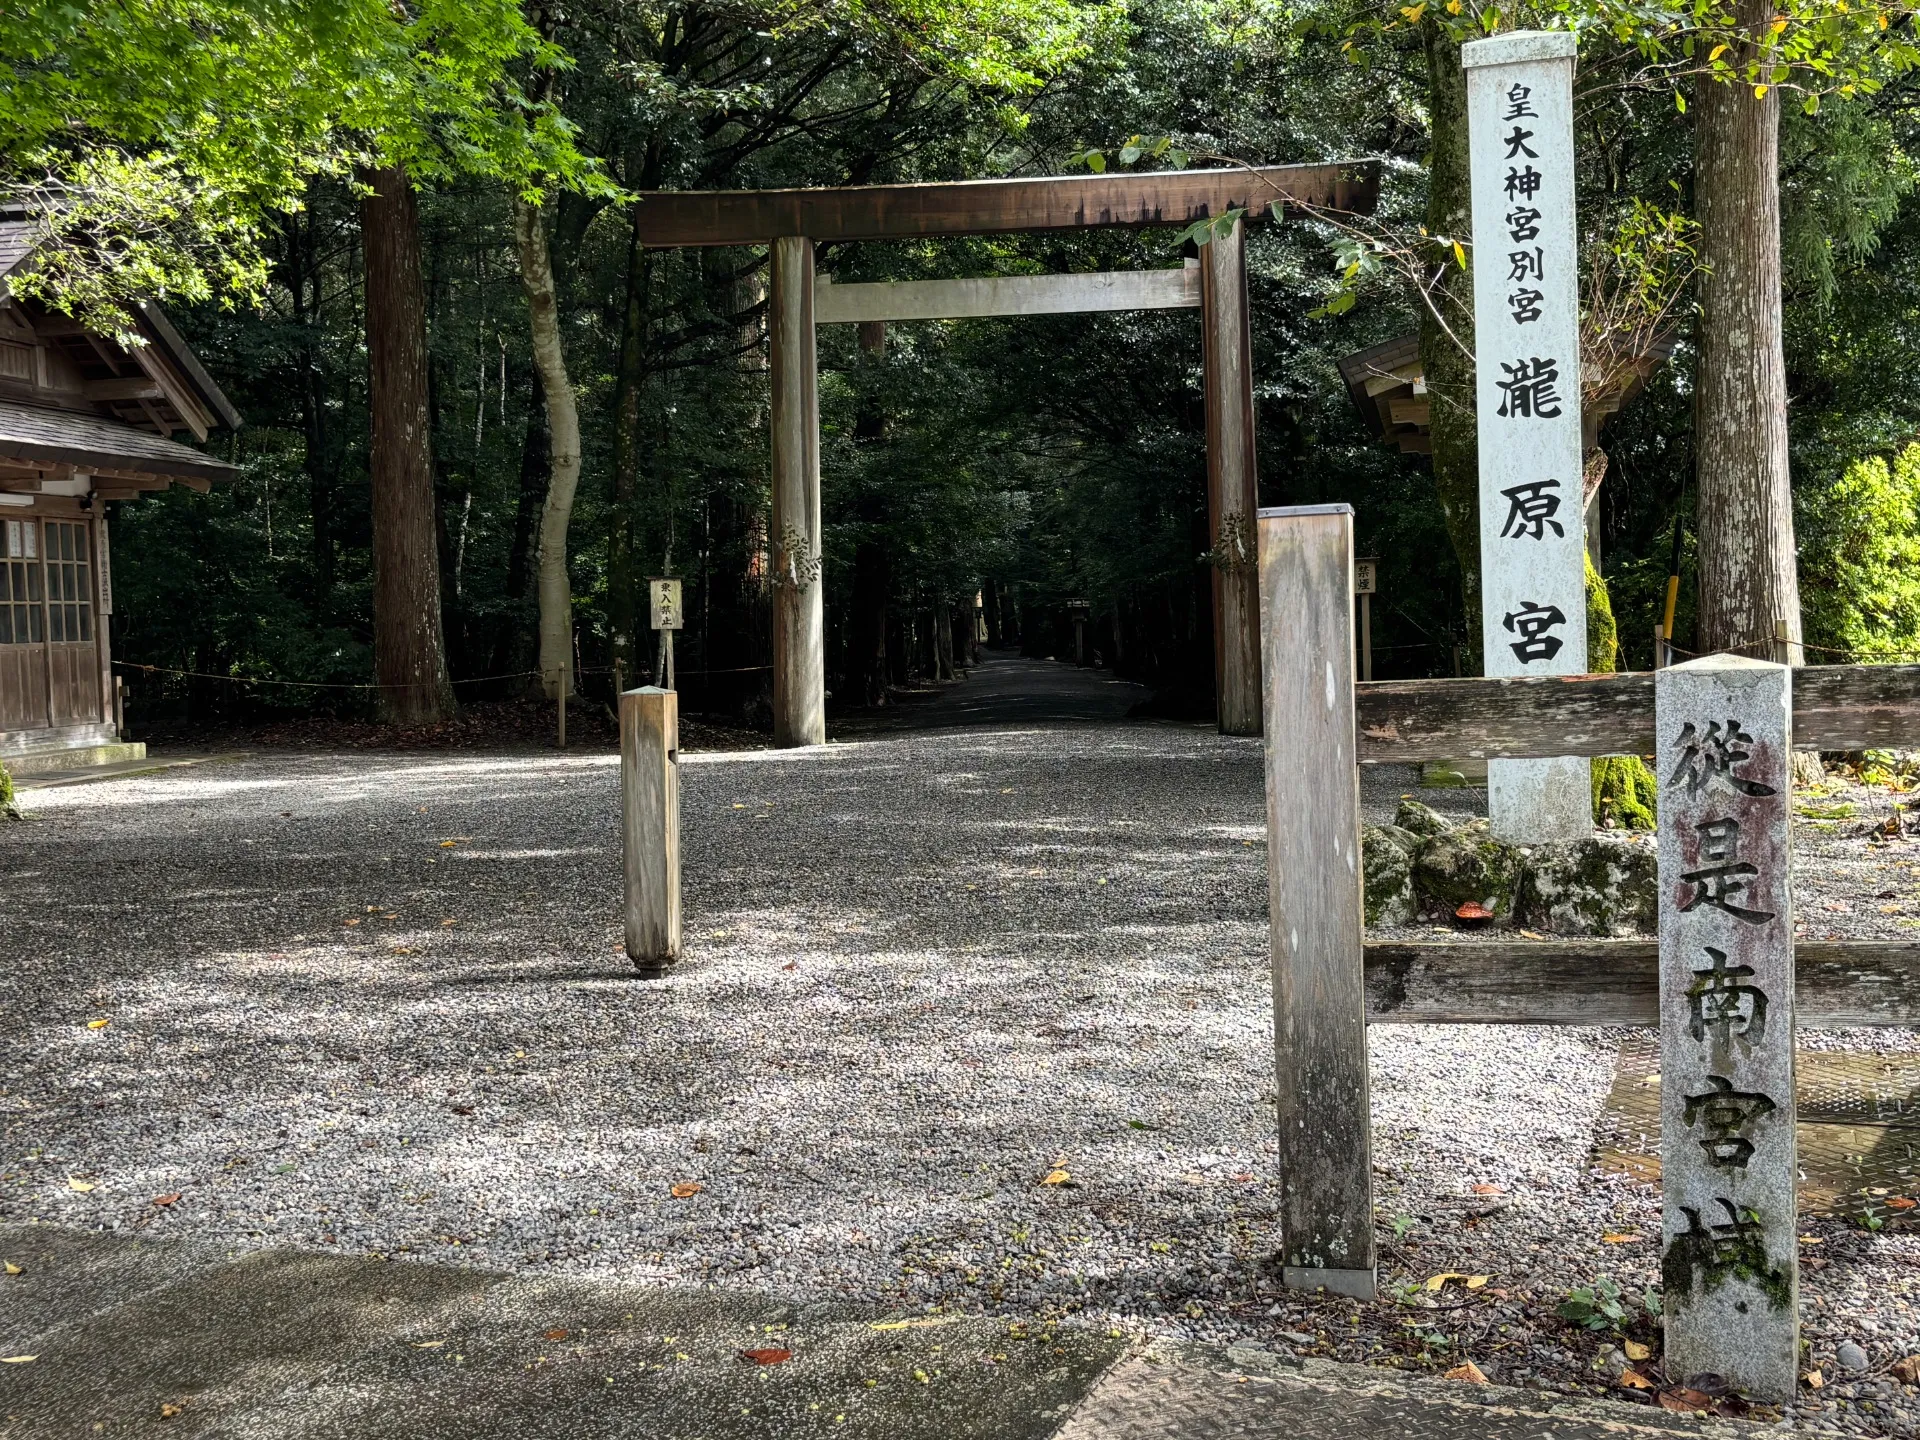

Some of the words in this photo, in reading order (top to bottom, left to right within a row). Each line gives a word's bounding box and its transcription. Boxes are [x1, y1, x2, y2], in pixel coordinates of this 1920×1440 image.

[1502, 82, 1545, 325] 皇大神宮別宮
[1357, 565, 1370, 590] 禁煙
[1495, 357, 1567, 665] 瀧原宮
